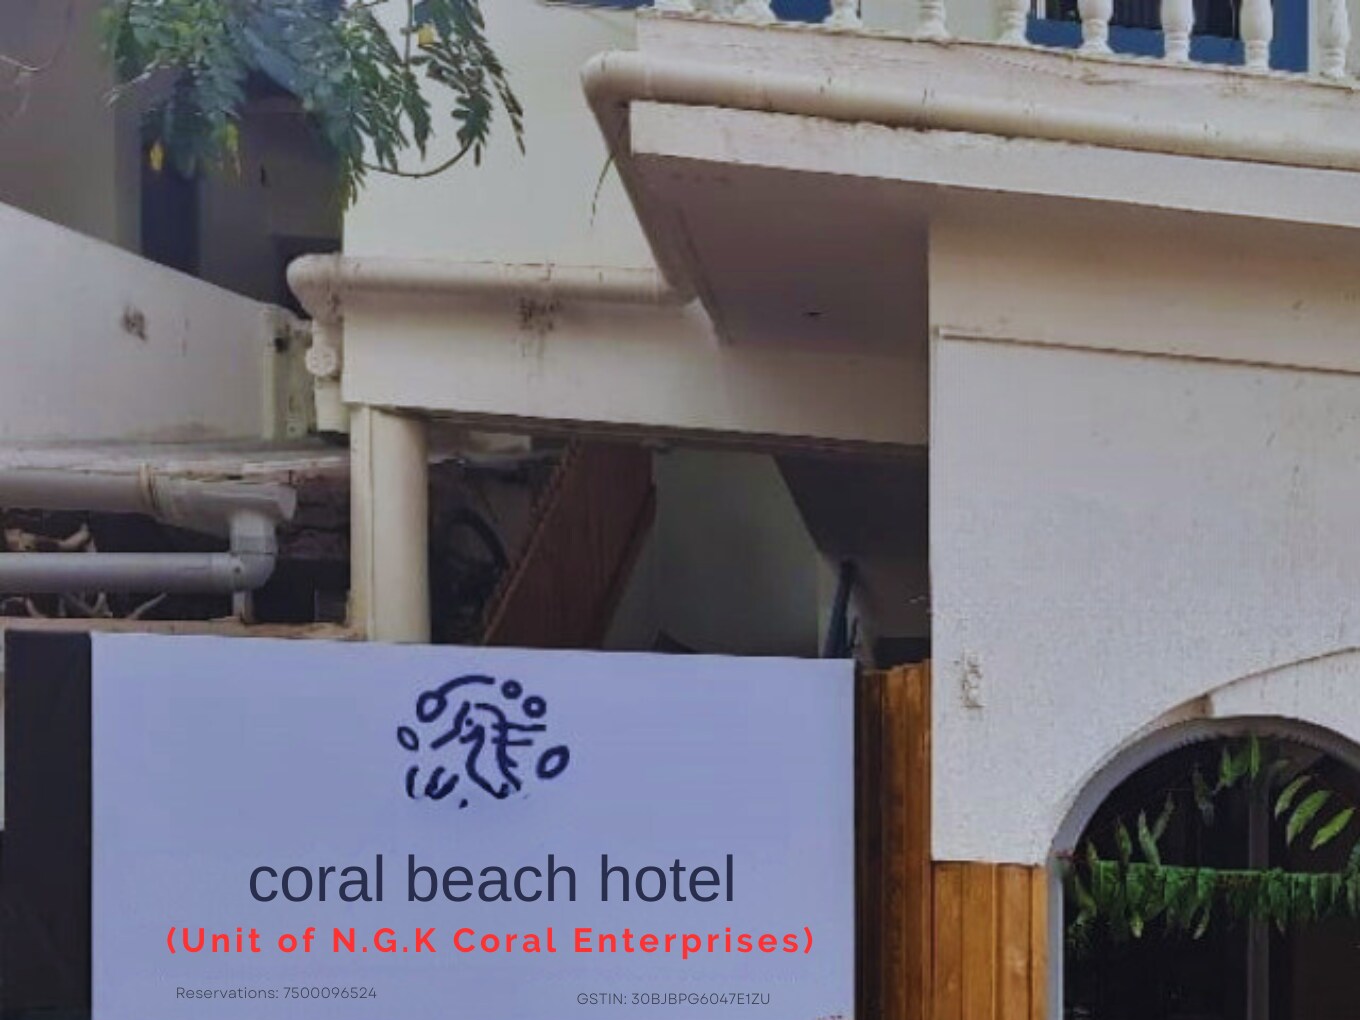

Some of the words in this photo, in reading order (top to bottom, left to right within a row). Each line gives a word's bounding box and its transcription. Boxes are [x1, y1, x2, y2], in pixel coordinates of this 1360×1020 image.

[250, 854, 383, 902] coral
[408, 854, 576, 902] beach
[602, 854, 733, 902] hotel
[166, 926, 261, 955] (Unit
[277, 926, 316, 953] of
[333, 927, 437, 953] N.G.K
[454, 927, 557, 953] Coral
[575, 926, 813, 961] Enterprises)
[176, 986, 279, 999] Reservations:
[283, 986, 377, 999] 7500096524
[576, 992, 627, 1005] GSTIN:
[631, 992, 770, 1005] 30BJBPG6047E1ZU
